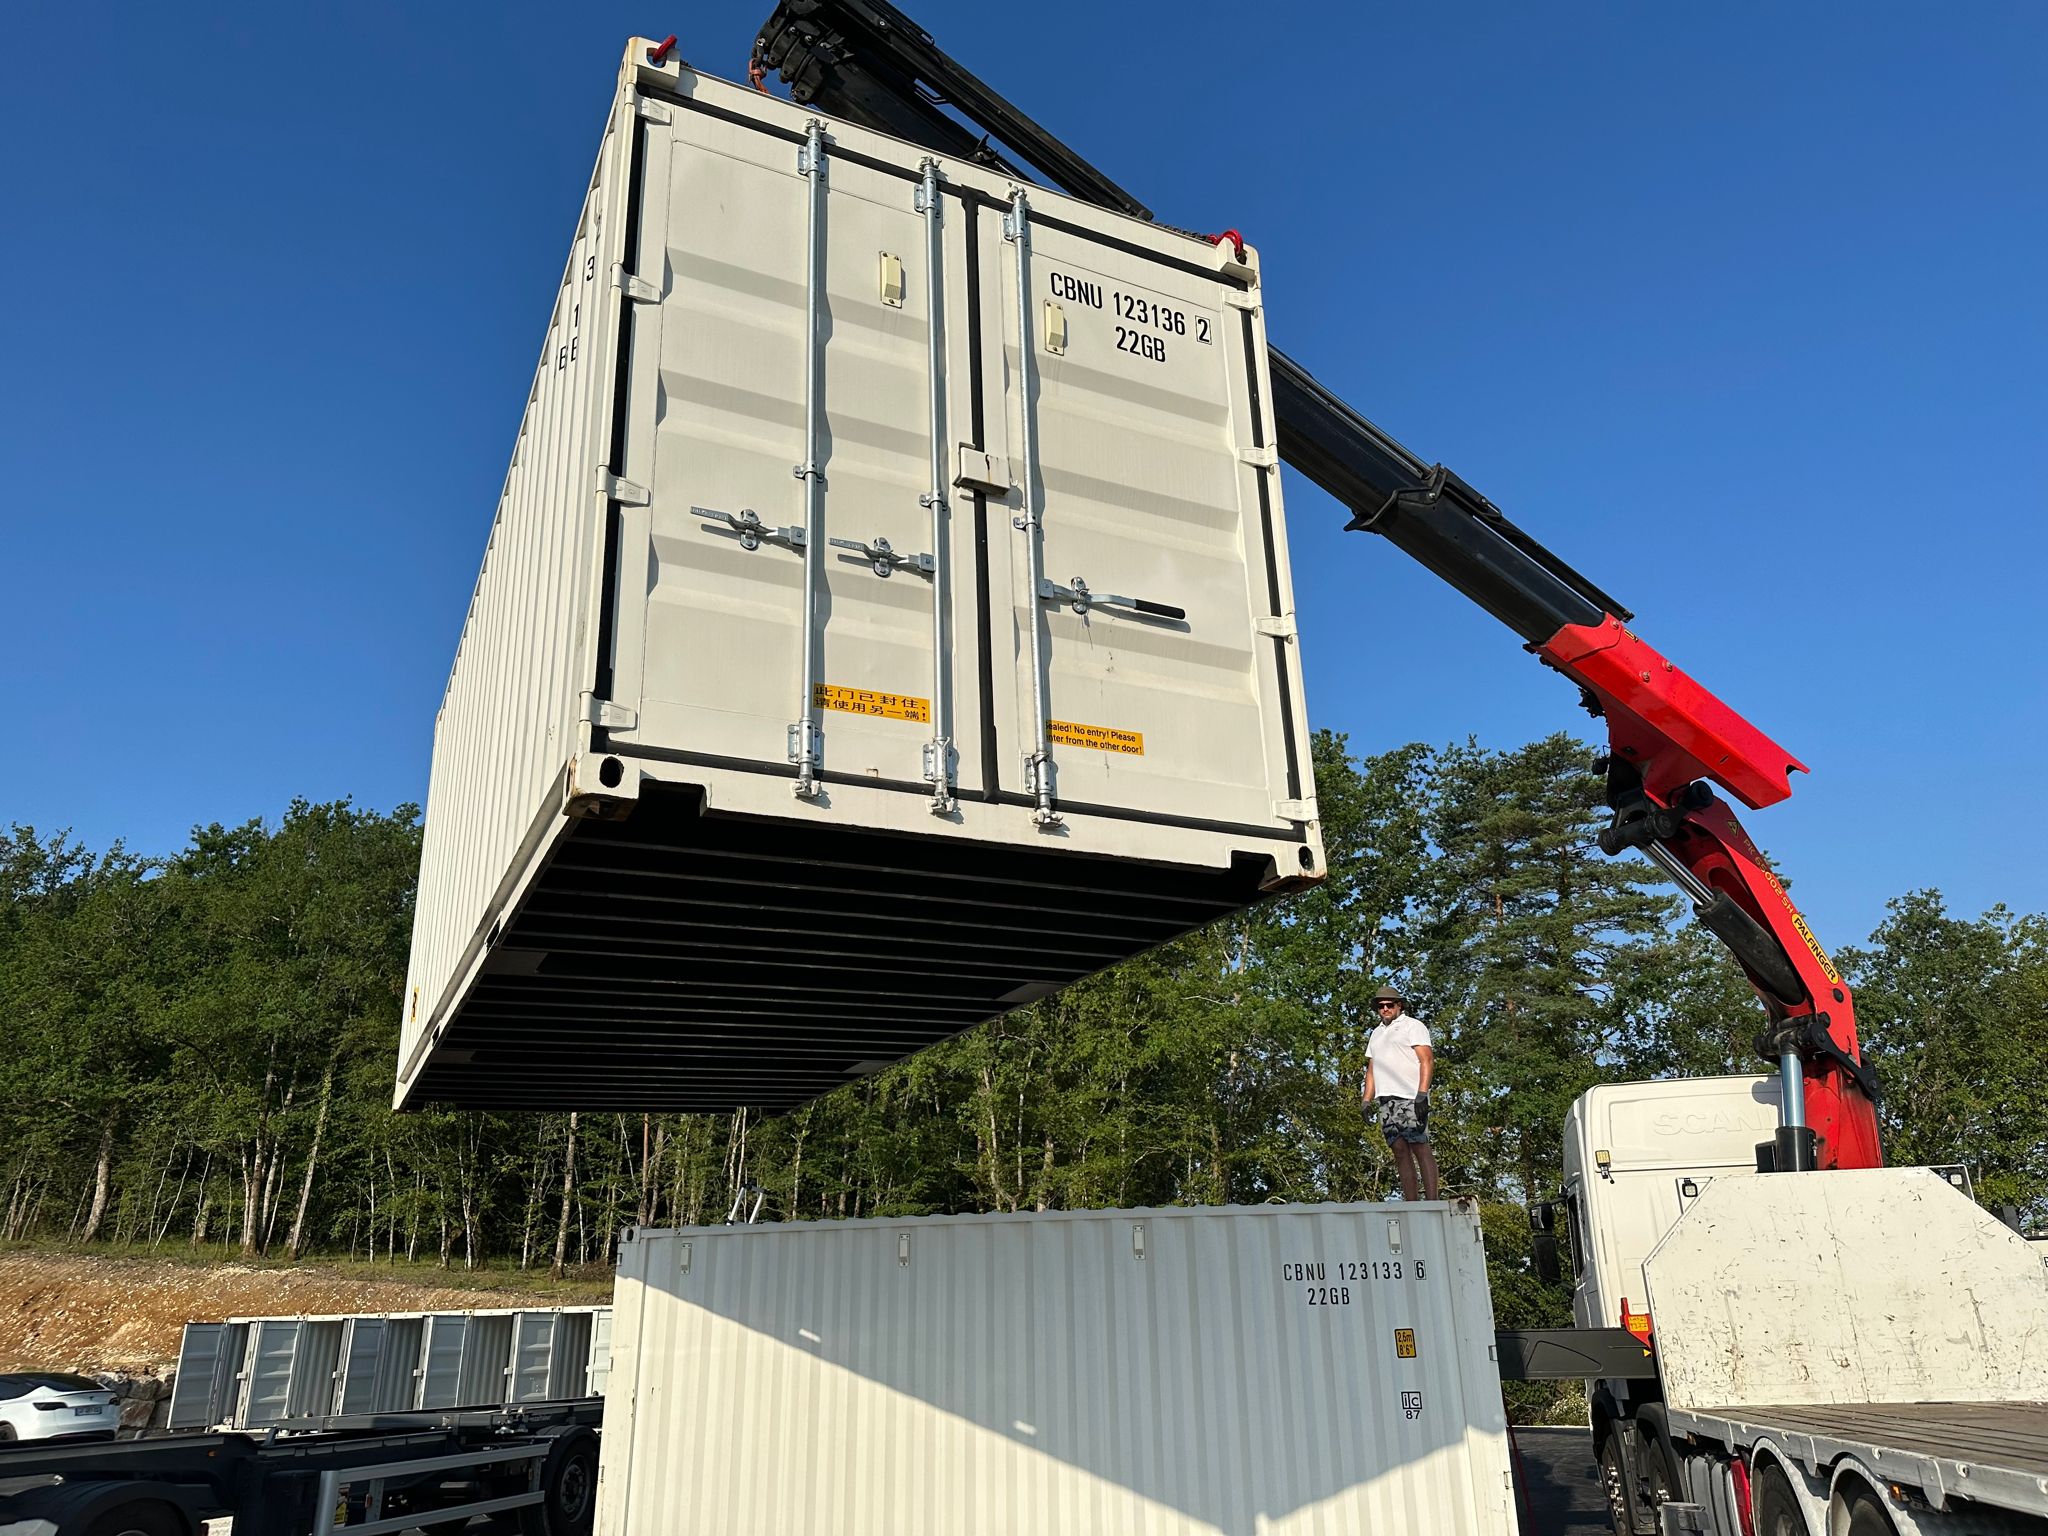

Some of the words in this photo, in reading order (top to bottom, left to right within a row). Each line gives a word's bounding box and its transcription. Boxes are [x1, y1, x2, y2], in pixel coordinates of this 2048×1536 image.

[1050, 272, 1103, 309] CBNU
[1113, 291, 1186, 336] 123136
[1197, 318, 1210, 343] 2
[1115, 326, 1166, 363] 22GB
[1074, 725, 1085, 735] No
[1086, 729, 1109, 740] entry!
[1111, 731, 1136, 742] Please
[1065, 735, 1084, 745] from
[1085, 738, 1098, 747] the
[1099, 741, 1120, 751] other
[1121, 744, 1143, 754] door!
[1744, 838, 1756, 855] PK
[1794, 917, 1837, 980] PALFINGER
[1652, 1108, 1776, 1136] SCANI
[1283, 1263, 1326, 1281] CBNU
[1338, 1262, 1403, 1280] 123133
[1415, 1261, 1425, 1279] 6
[1307, 1287, 1350, 1306] 22GB
[1405, 1409, 1420, 1420] 87
